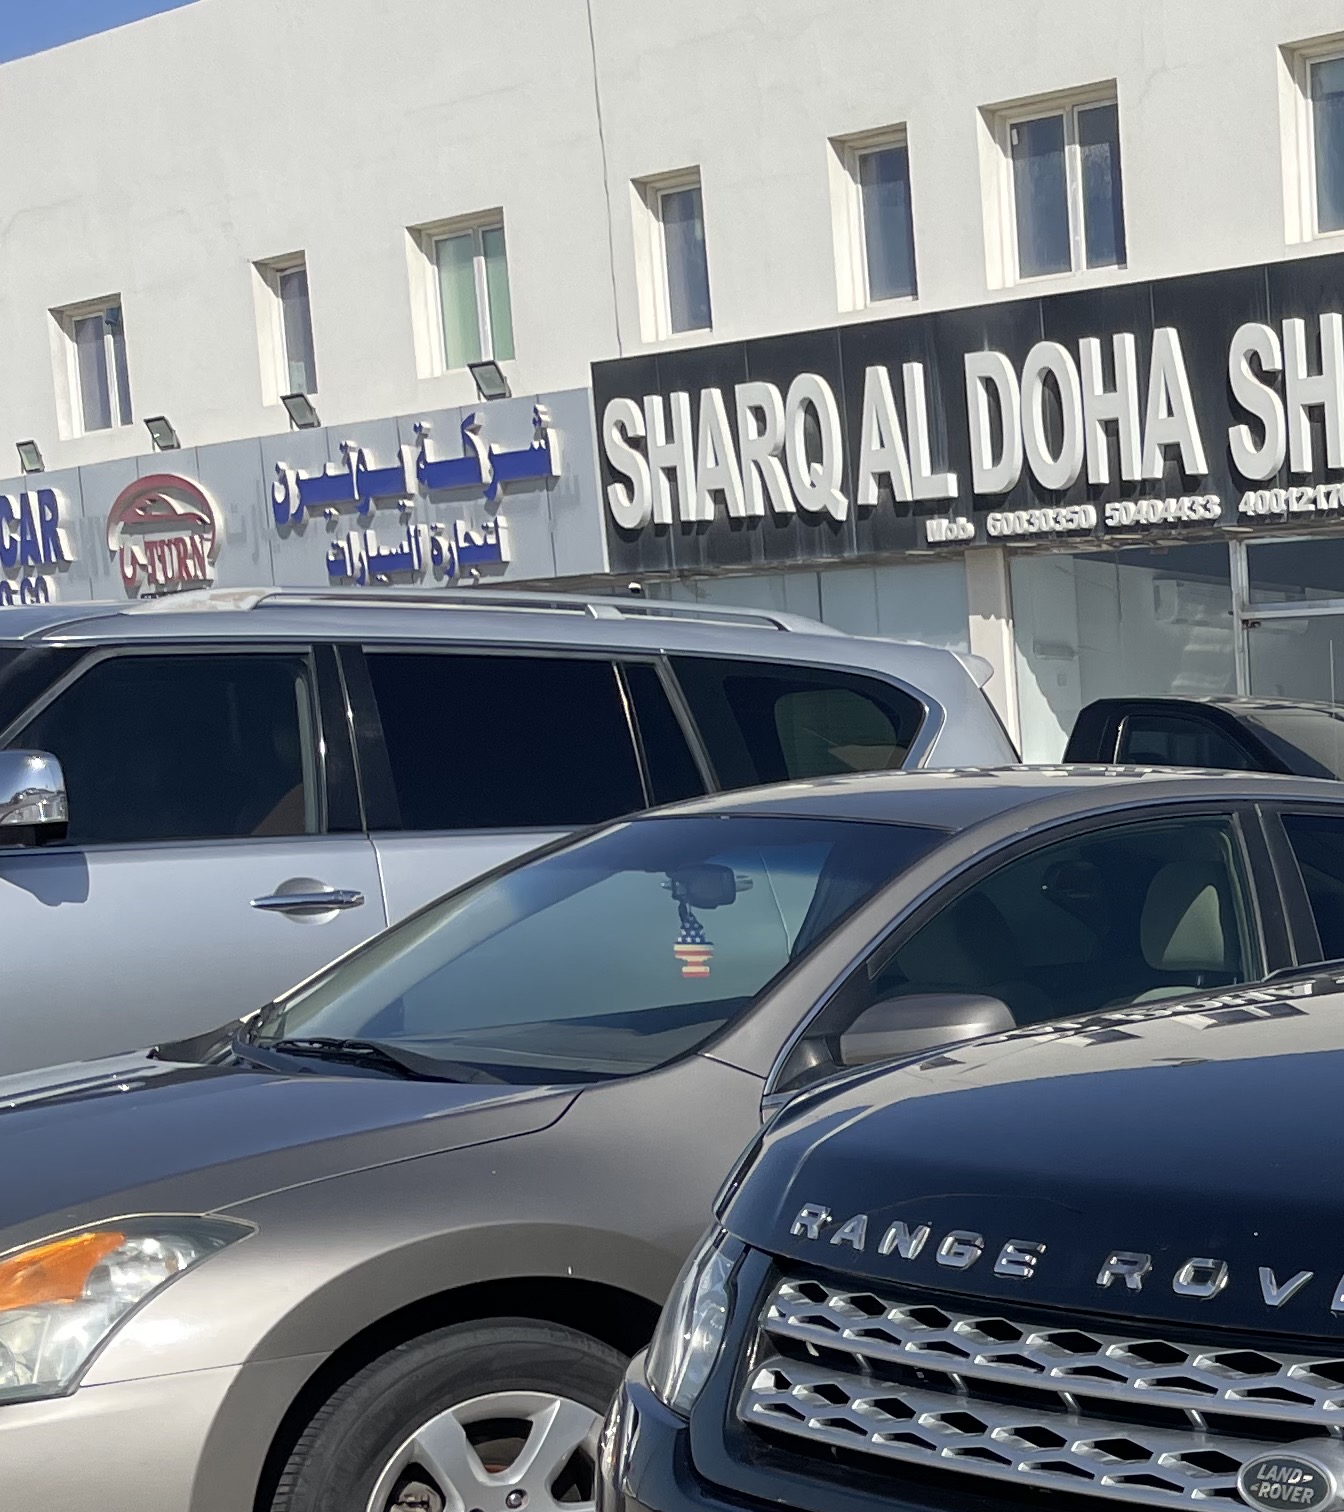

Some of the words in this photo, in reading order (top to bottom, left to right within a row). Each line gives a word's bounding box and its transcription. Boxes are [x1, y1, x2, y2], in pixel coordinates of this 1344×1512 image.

[603, 372, 848, 529] SHARQ
[858, 361, 959, 505] AL
[965, 327, 1209, 494] DOHA
[987, 504, 1098, 536] 60030350
[1104, 494, 1222, 527] 50404433
[789, 1202, 1048, 1280] RANGE
[1256, 1463, 1303, 1484] LAND
[1257, 1481, 1315, 1504] ROVER
